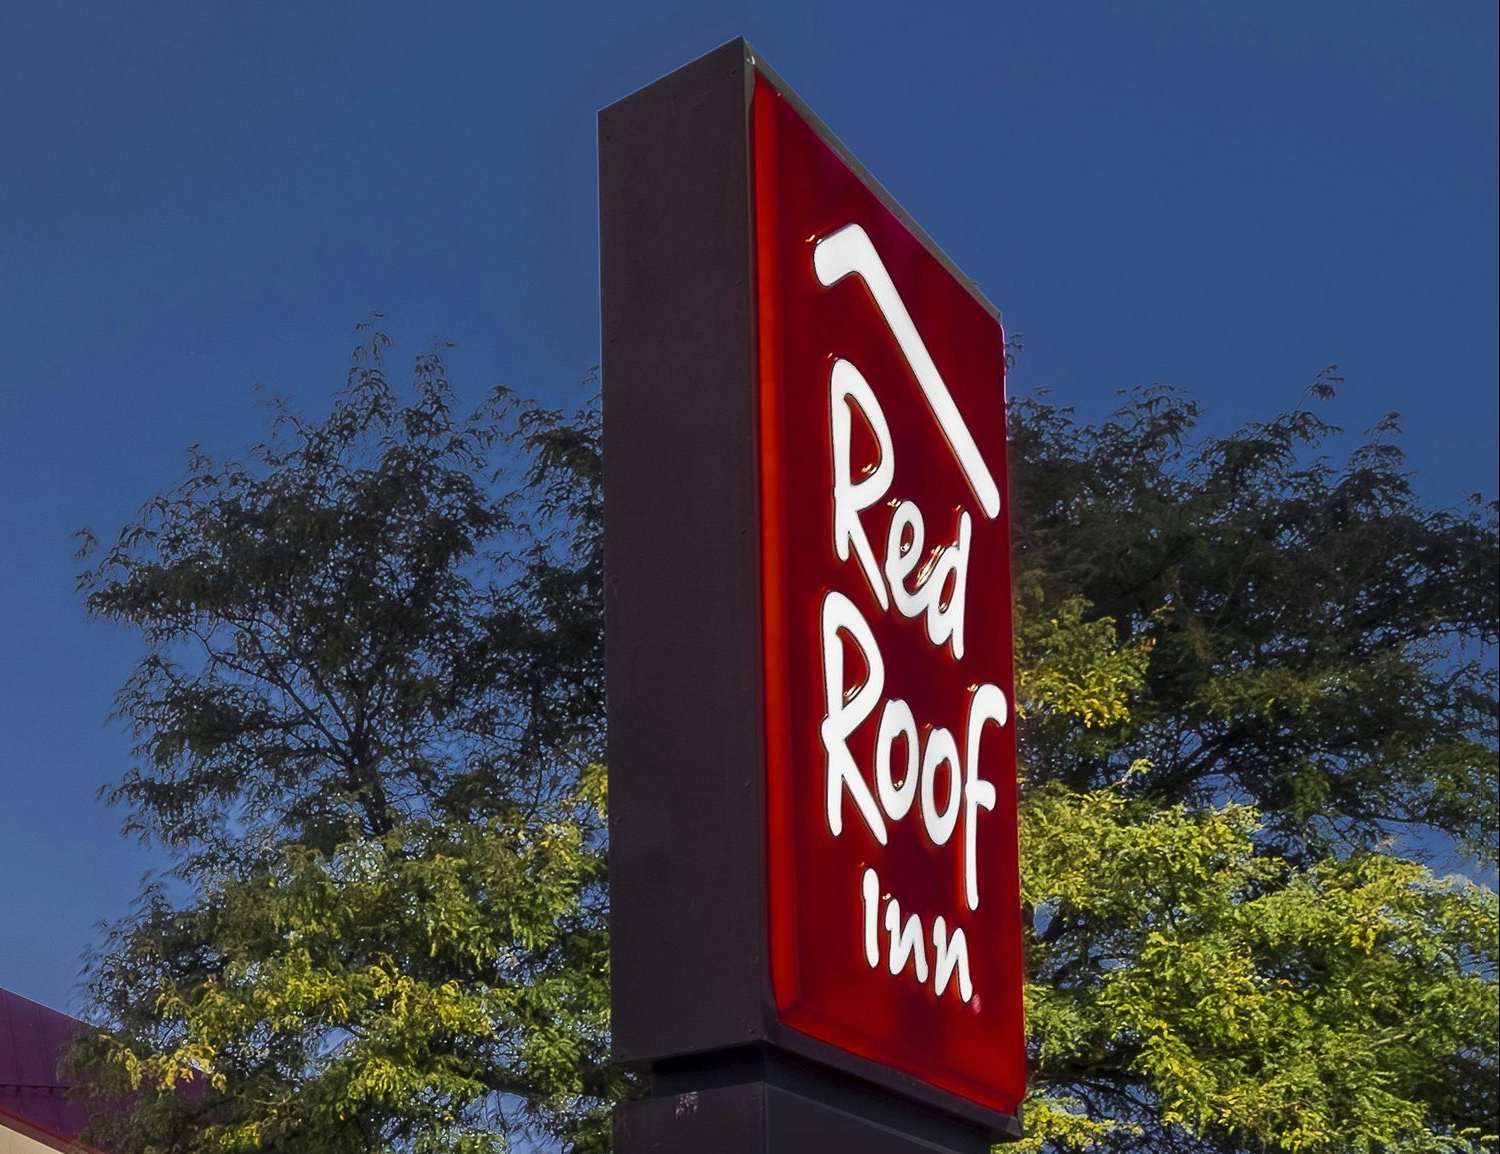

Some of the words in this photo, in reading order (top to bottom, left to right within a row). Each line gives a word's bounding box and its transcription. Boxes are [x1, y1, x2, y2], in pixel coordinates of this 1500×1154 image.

[829, 357, 973, 661] Red
[820, 589, 1009, 912] Roof
[861, 867, 974, 1004] Inn
